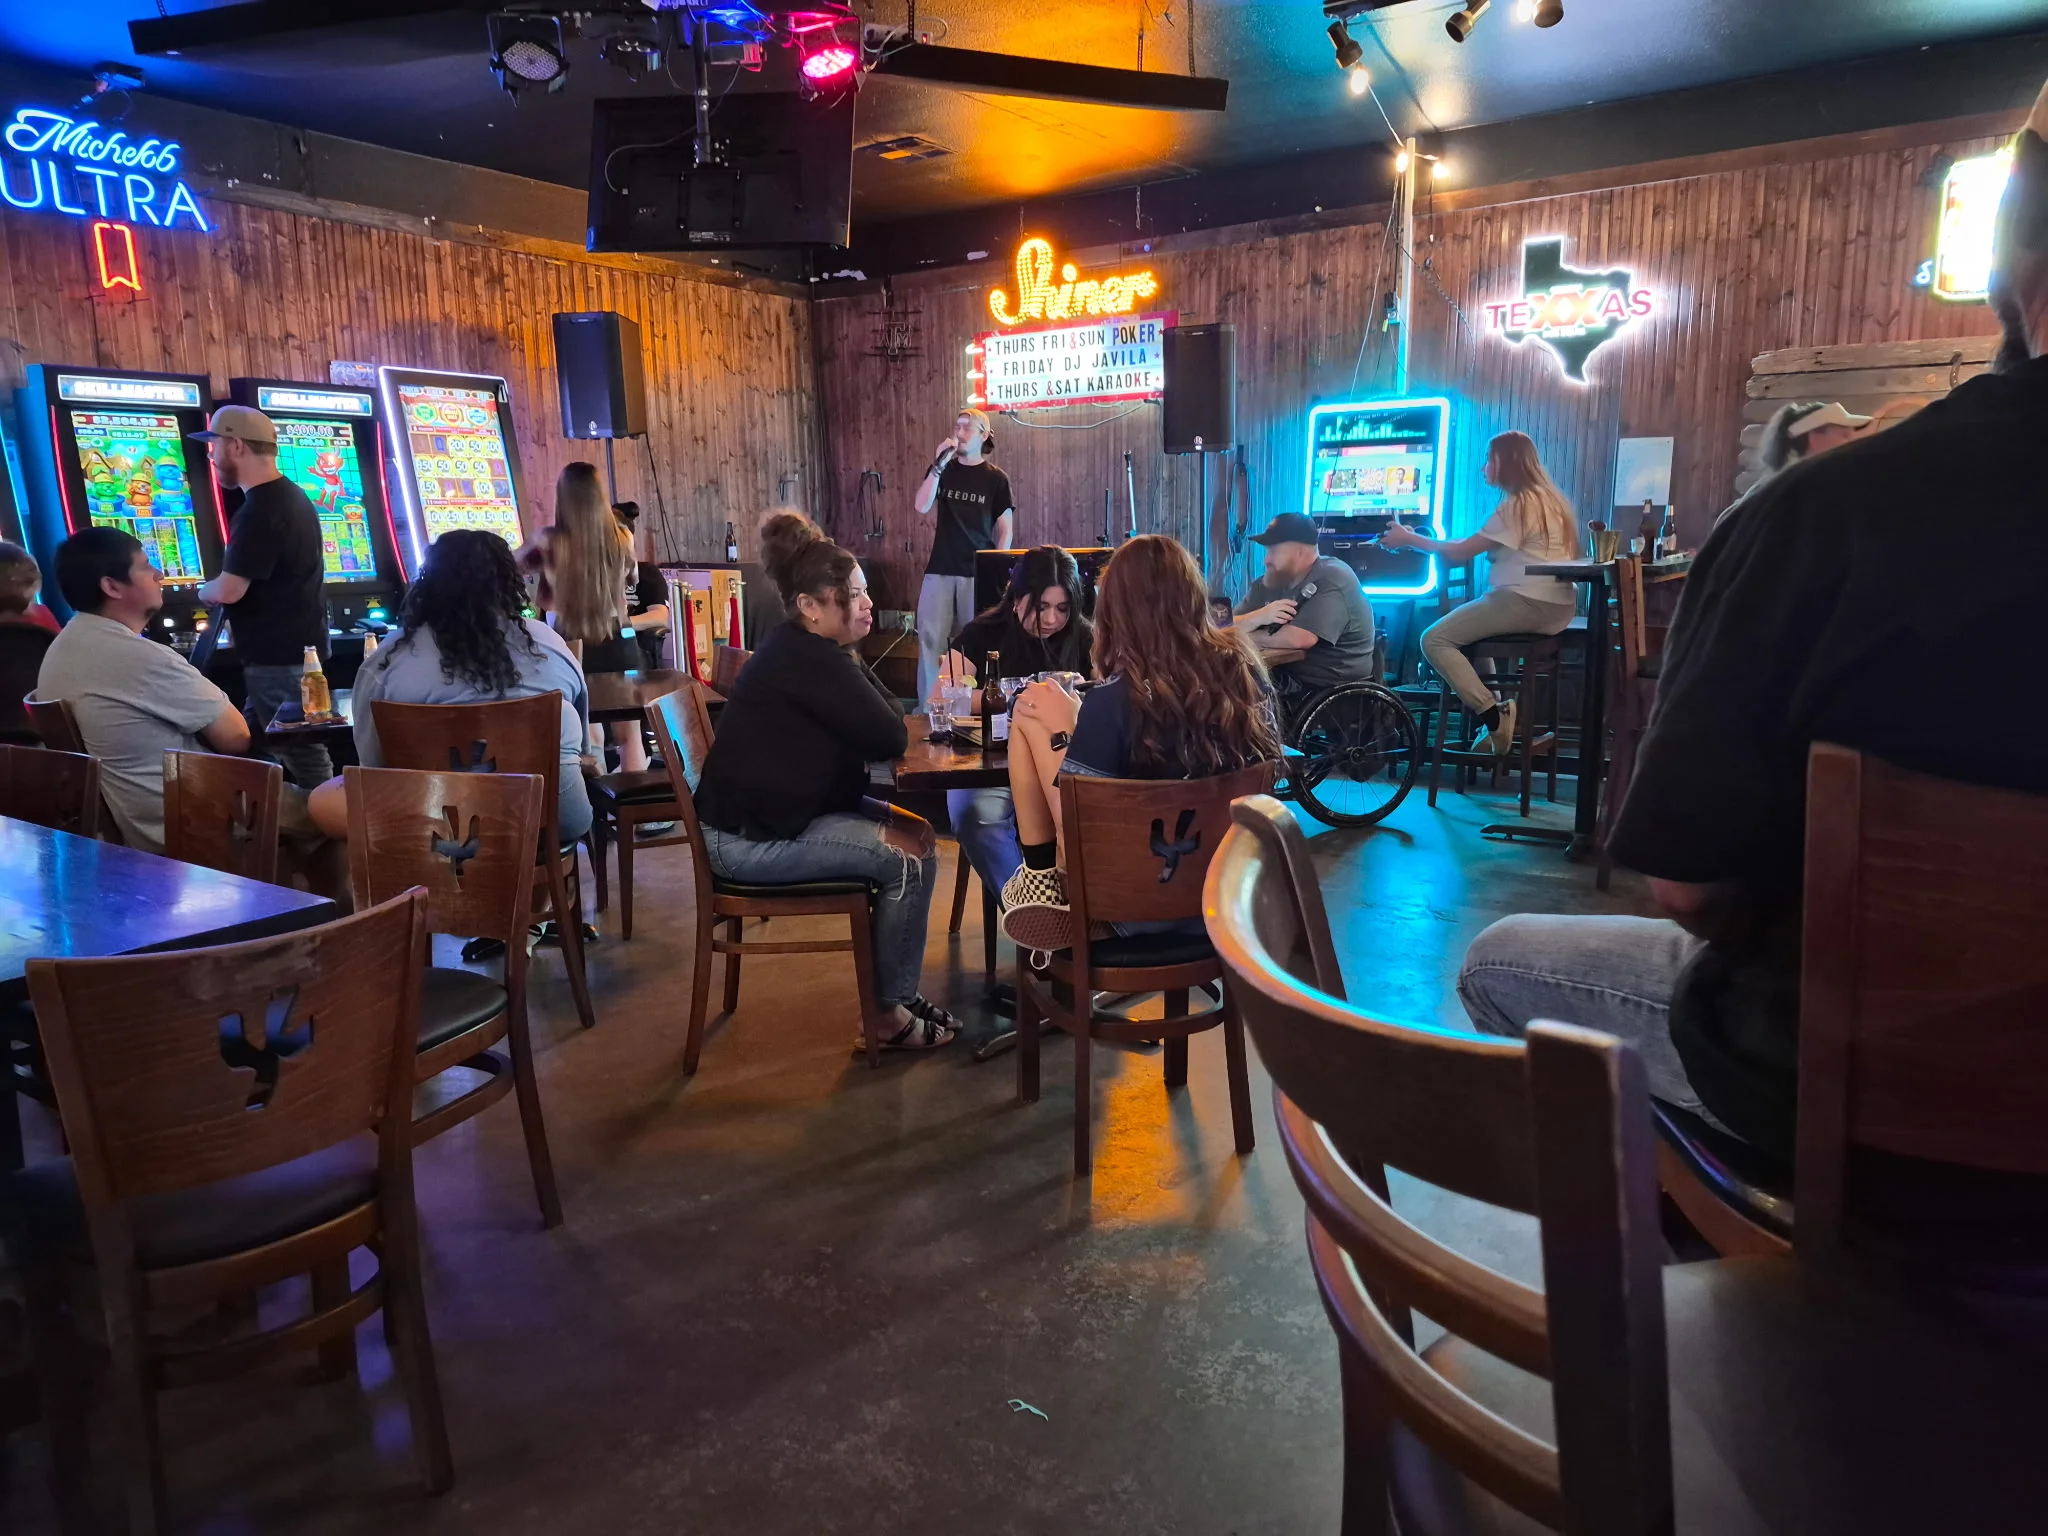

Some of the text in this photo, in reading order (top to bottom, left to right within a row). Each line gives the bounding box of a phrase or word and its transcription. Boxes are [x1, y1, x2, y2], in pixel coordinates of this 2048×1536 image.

[0, 154, 209, 232] ULTRA
[988, 237, 1158, 325] Shiner
[994, 336, 1036, 356] THURS
[1111, 323, 1156, 346] POKER
[1002, 348, 1147, 377] FRIDAY DJ JAVILA
[997, 381, 1039, 400] THURS
[1086, 371, 1152, 392] KARAOKE
[285, 424, 334, 438] $400.00
[469, 440, 482, 451] 50
[437, 460, 450, 470] 50
[454, 460, 468, 470] 50
[472, 461, 486, 471] 50
